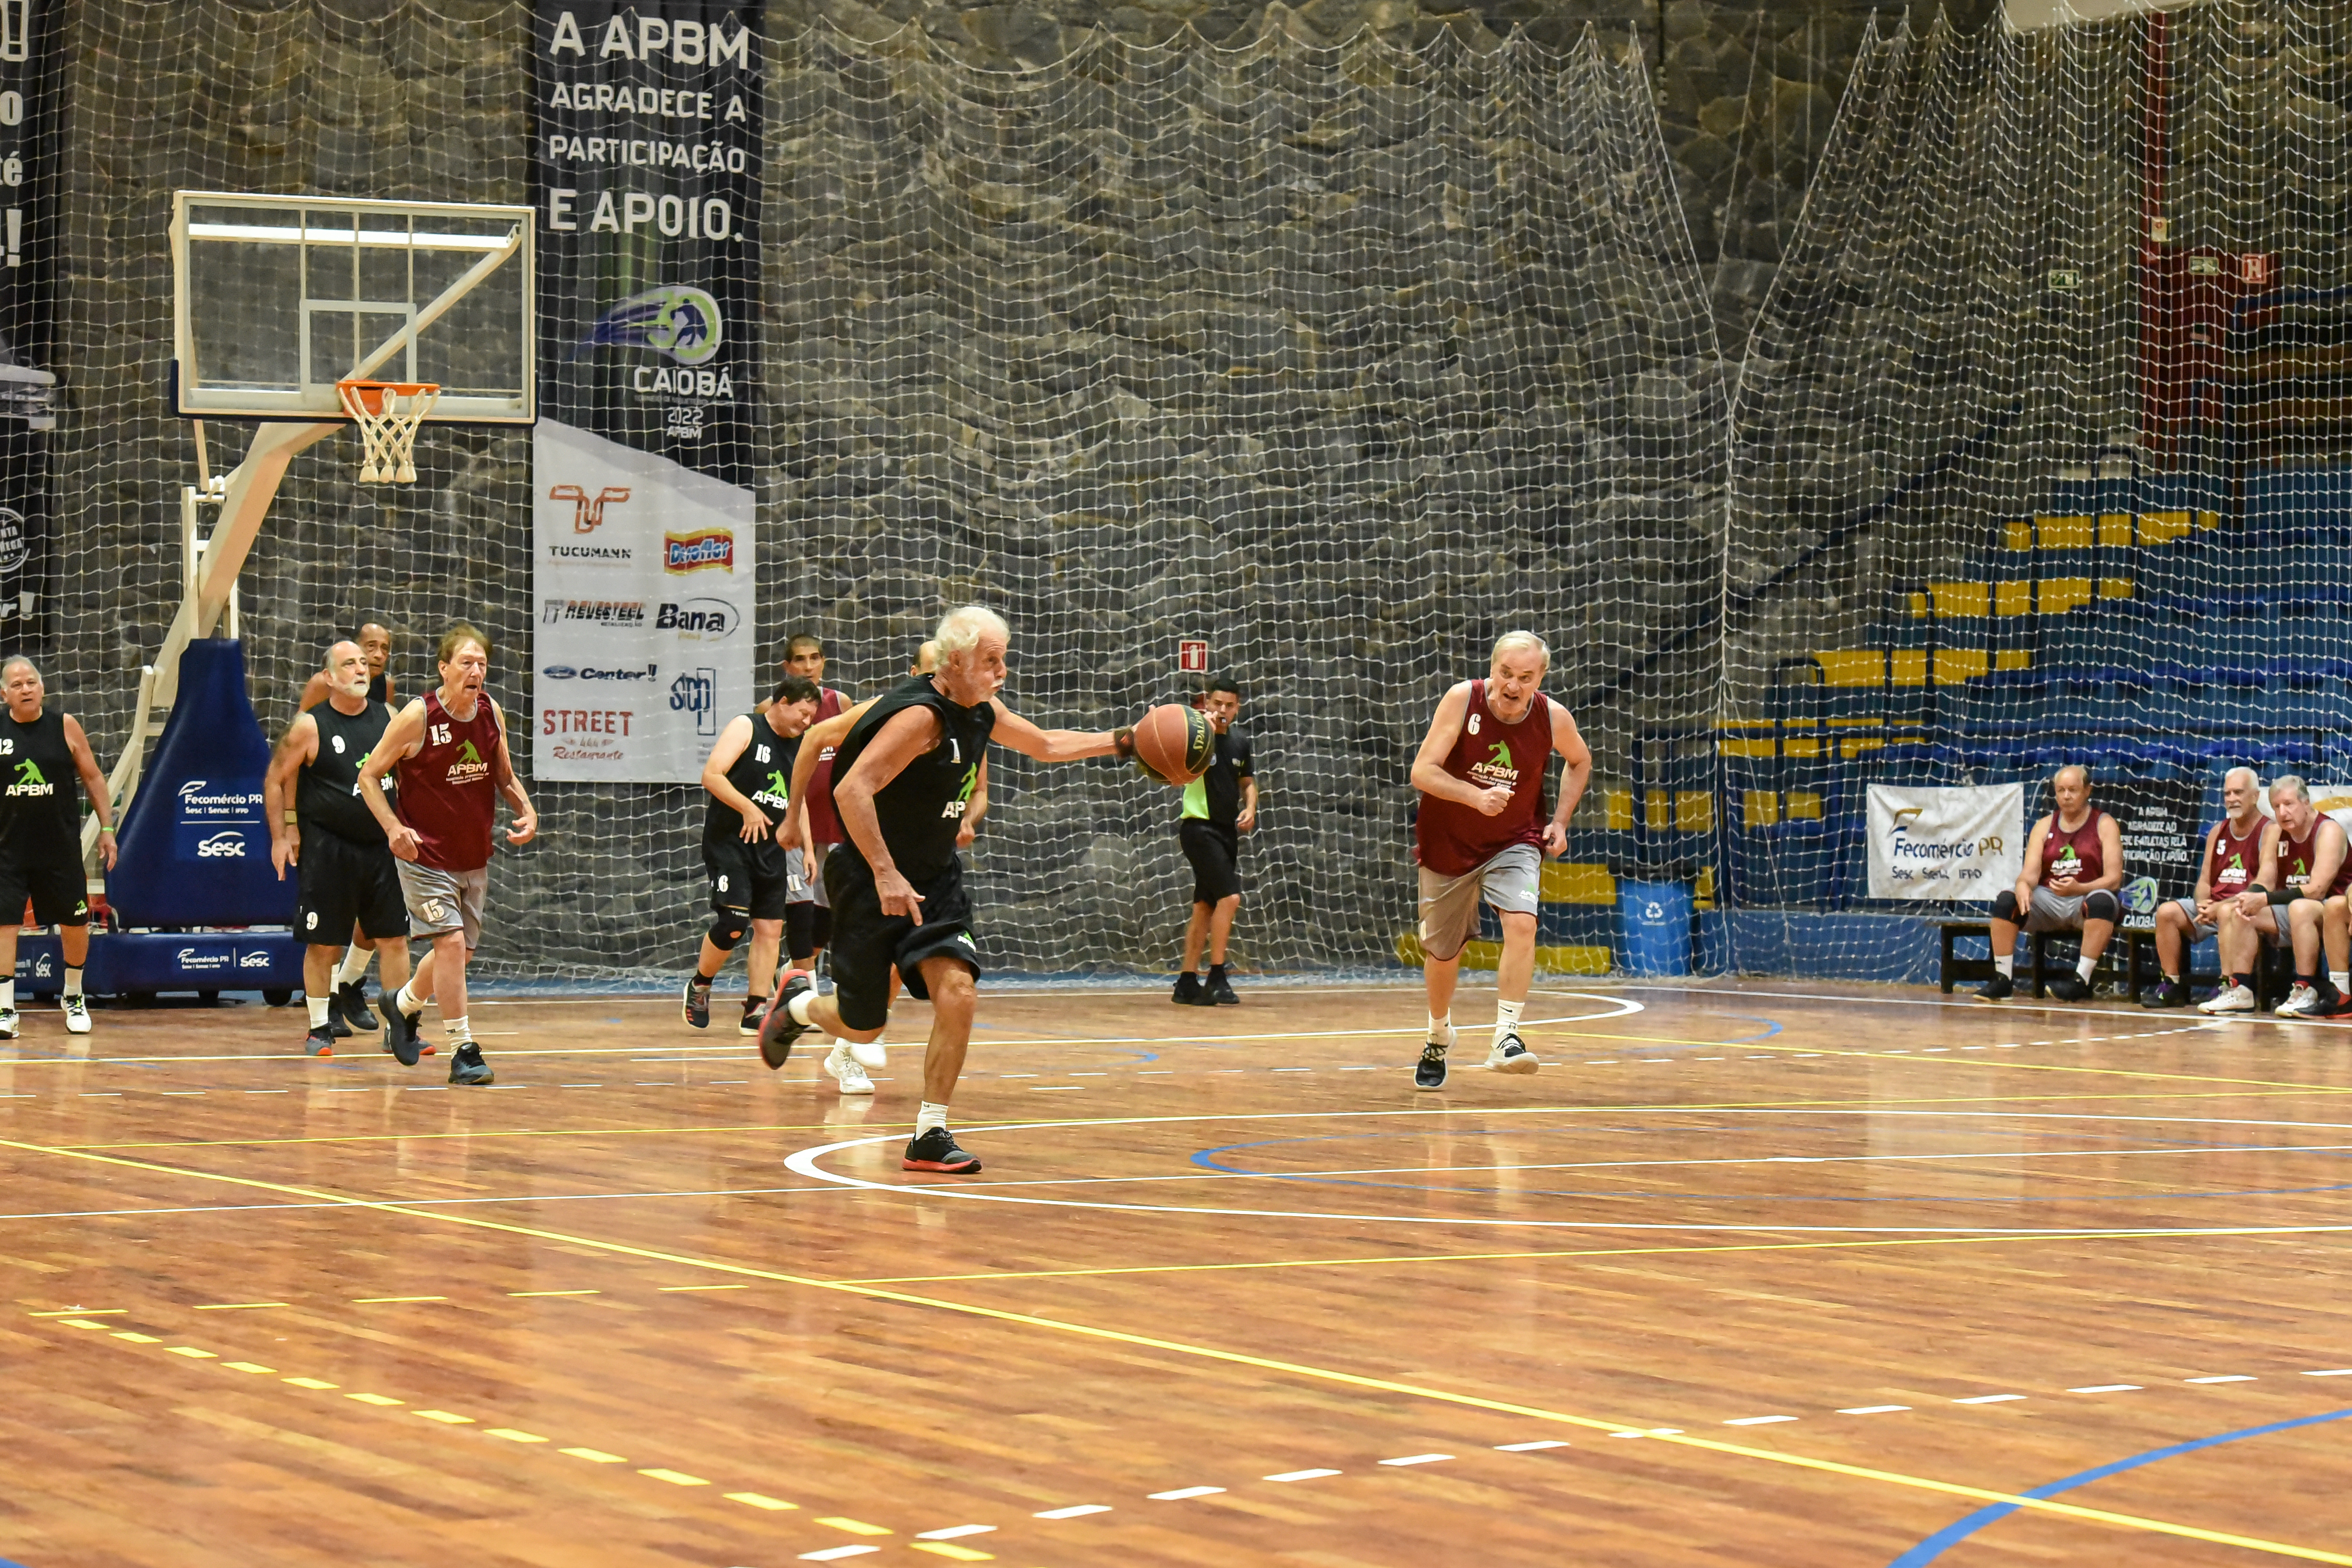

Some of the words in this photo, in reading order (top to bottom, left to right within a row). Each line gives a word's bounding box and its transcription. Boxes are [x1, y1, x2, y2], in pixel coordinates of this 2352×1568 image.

[549, 11, 585, 57] A
[599, 15, 749, 69] APBM
[550, 82, 712, 119] AGRADECE
[724, 95, 746, 123] A
[549, 135, 745, 173] PARTICIPAÇÃO
[550, 188, 577, 230] E
[591, 191, 743, 241] APOIO.
[634, 366, 733, 398] CAIOBÁ
[668, 407, 703, 425] 2022
[548, 546, 631, 559] TUCUMANN
[655, 603, 725, 632] Bana
[543, 709, 633, 736] STREET
[1468, 713, 1481, 735] 6
[430, 722, 452, 746] 15
[332, 735, 346, 754] 9
[553, 746, 623, 760] Restaurante
[755, 744, 771, 764] 16
[950, 738, 961, 764] 1
[447, 762, 488, 777] APBM
[1471, 762, 1520, 780] APBM
[5, 783, 54, 797] APBM
[185, 793, 247, 804] Fecomércio
[248, 794, 263, 804] PR
[941, 801, 966, 818] AP
[197, 838, 246, 857] Sesc
[1893, 837, 1975, 859] Fecomércio
[1978, 836, 2004, 856] PR
[2216, 839, 2226, 855] 5
[421, 898, 445, 922] 15
[307, 912, 318, 930] 9
[240, 956, 270, 967] Sesc
